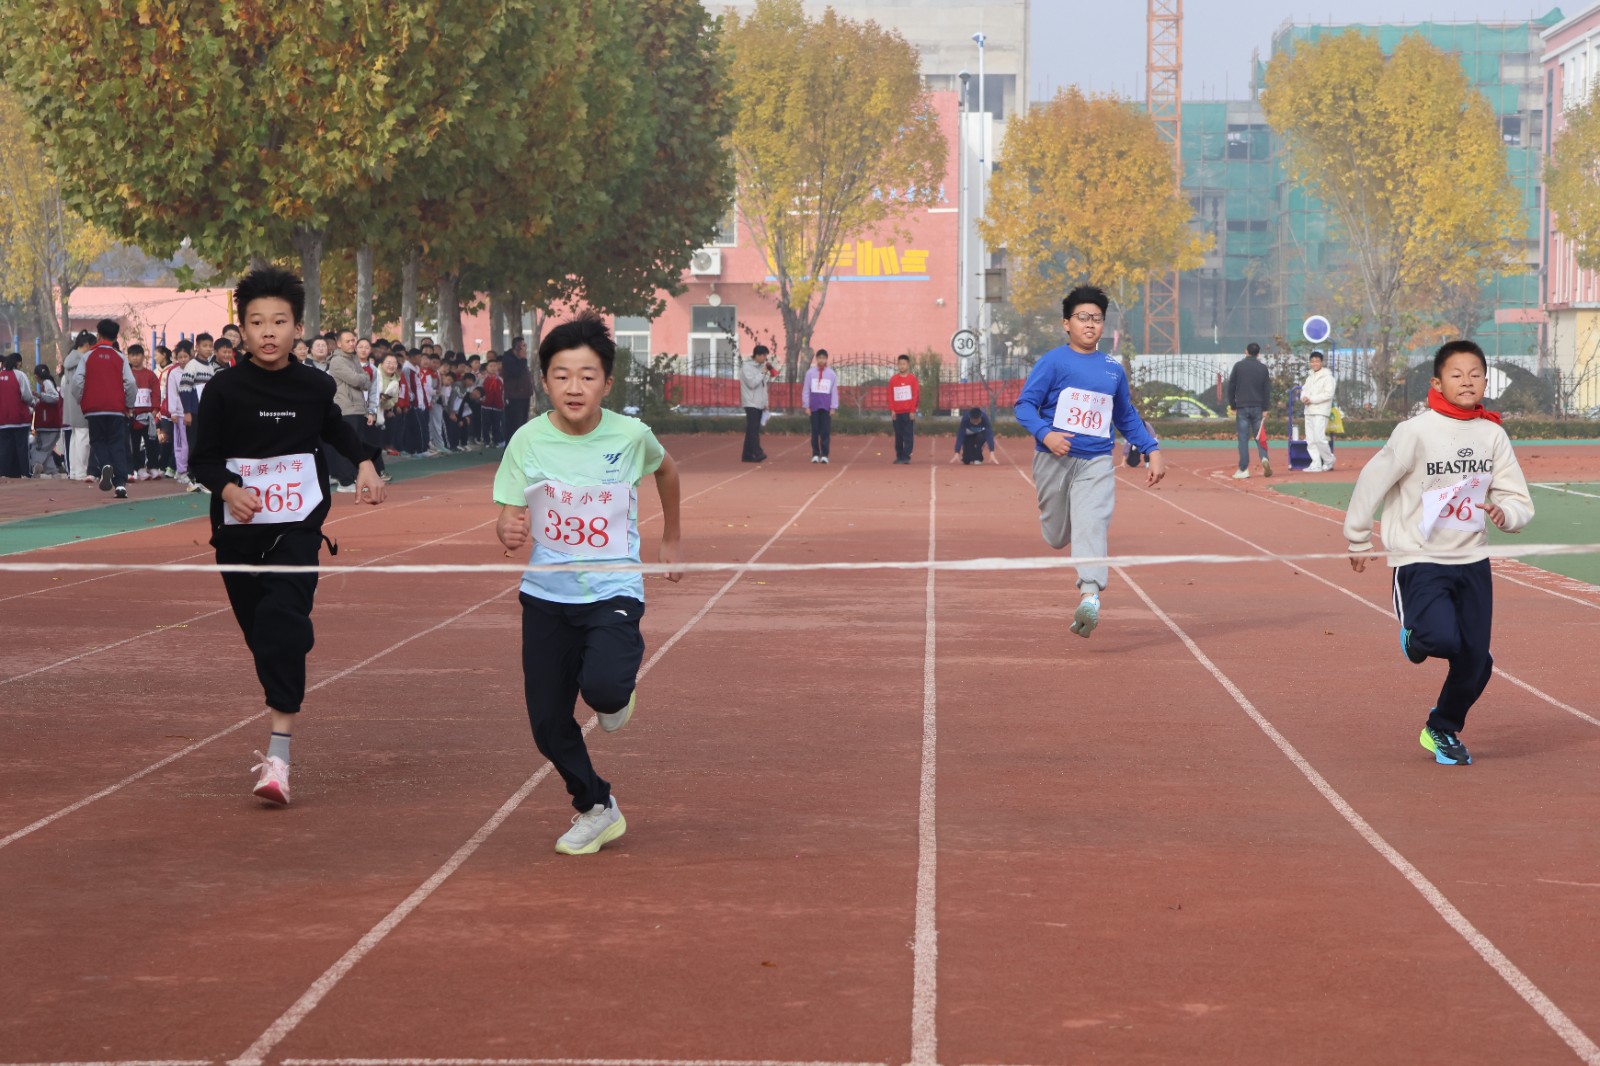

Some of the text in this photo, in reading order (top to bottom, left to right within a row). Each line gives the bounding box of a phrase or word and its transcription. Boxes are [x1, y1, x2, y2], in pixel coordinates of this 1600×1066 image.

[957, 338, 974, 350] 30
[259, 410, 296, 418] blossoming
[1067, 407, 1103, 430] 369
[239, 459, 303, 477] 招贤小学
[544, 483, 613, 506] 招贤小学
[544, 509, 610, 548] 338
